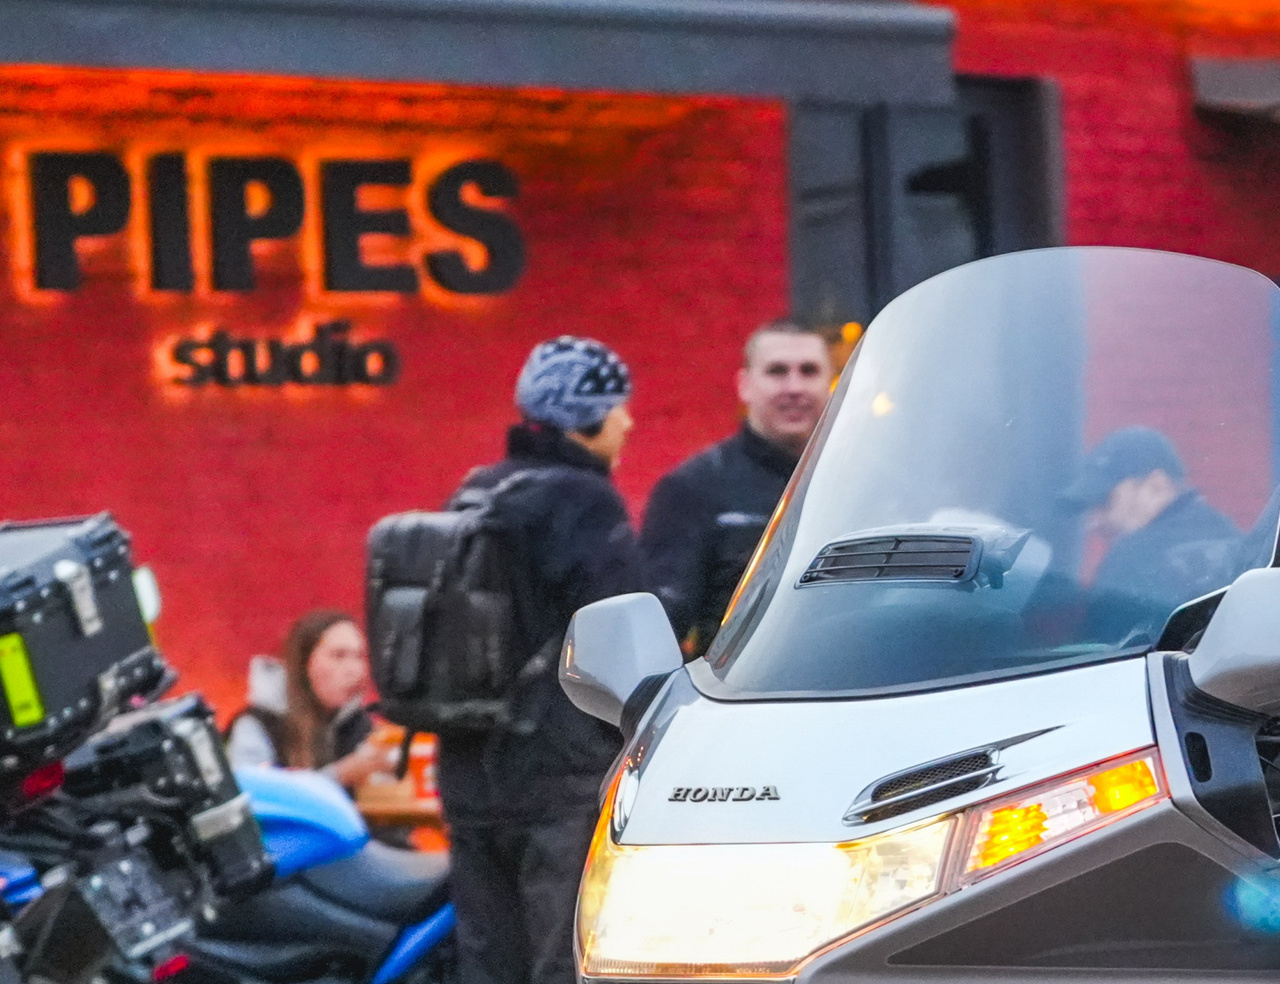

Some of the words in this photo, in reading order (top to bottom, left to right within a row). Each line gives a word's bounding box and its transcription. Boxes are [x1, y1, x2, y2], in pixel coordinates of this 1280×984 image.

[28, 151, 525, 295] PIPES
[172, 319, 399, 386] studio
[668, 785, 781, 803] HONDA
